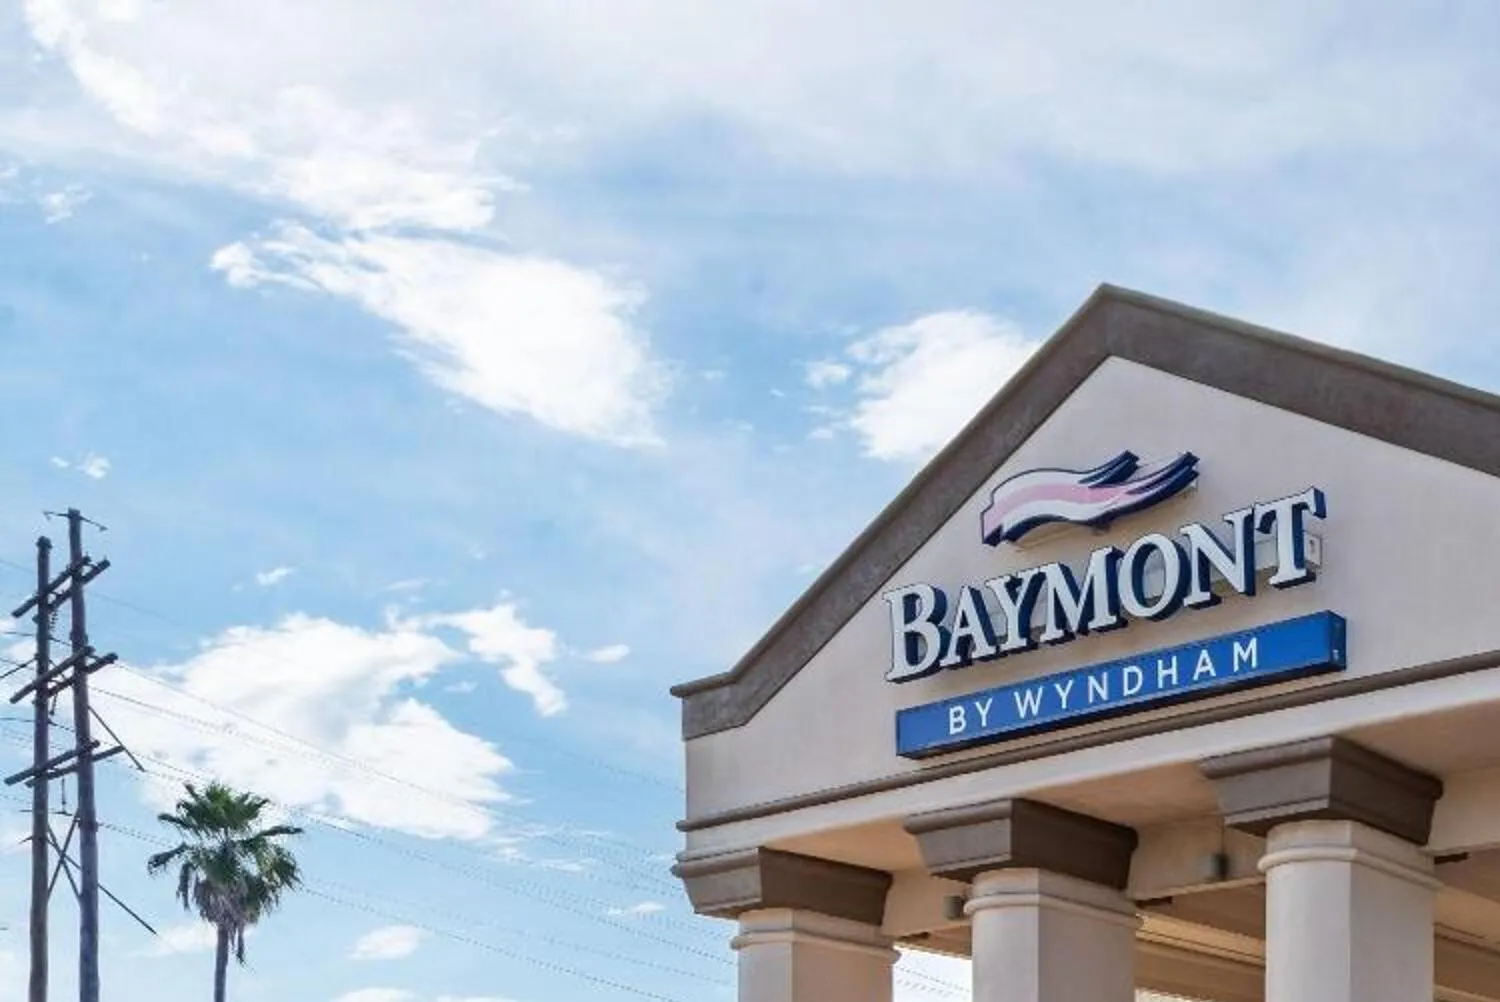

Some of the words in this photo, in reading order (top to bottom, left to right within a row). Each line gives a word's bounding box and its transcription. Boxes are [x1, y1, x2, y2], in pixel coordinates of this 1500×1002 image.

[884, 487, 1327, 683] BAYMONT
[949, 698, 994, 735] BY
[1013, 637, 1259, 719] WYNDHAM
